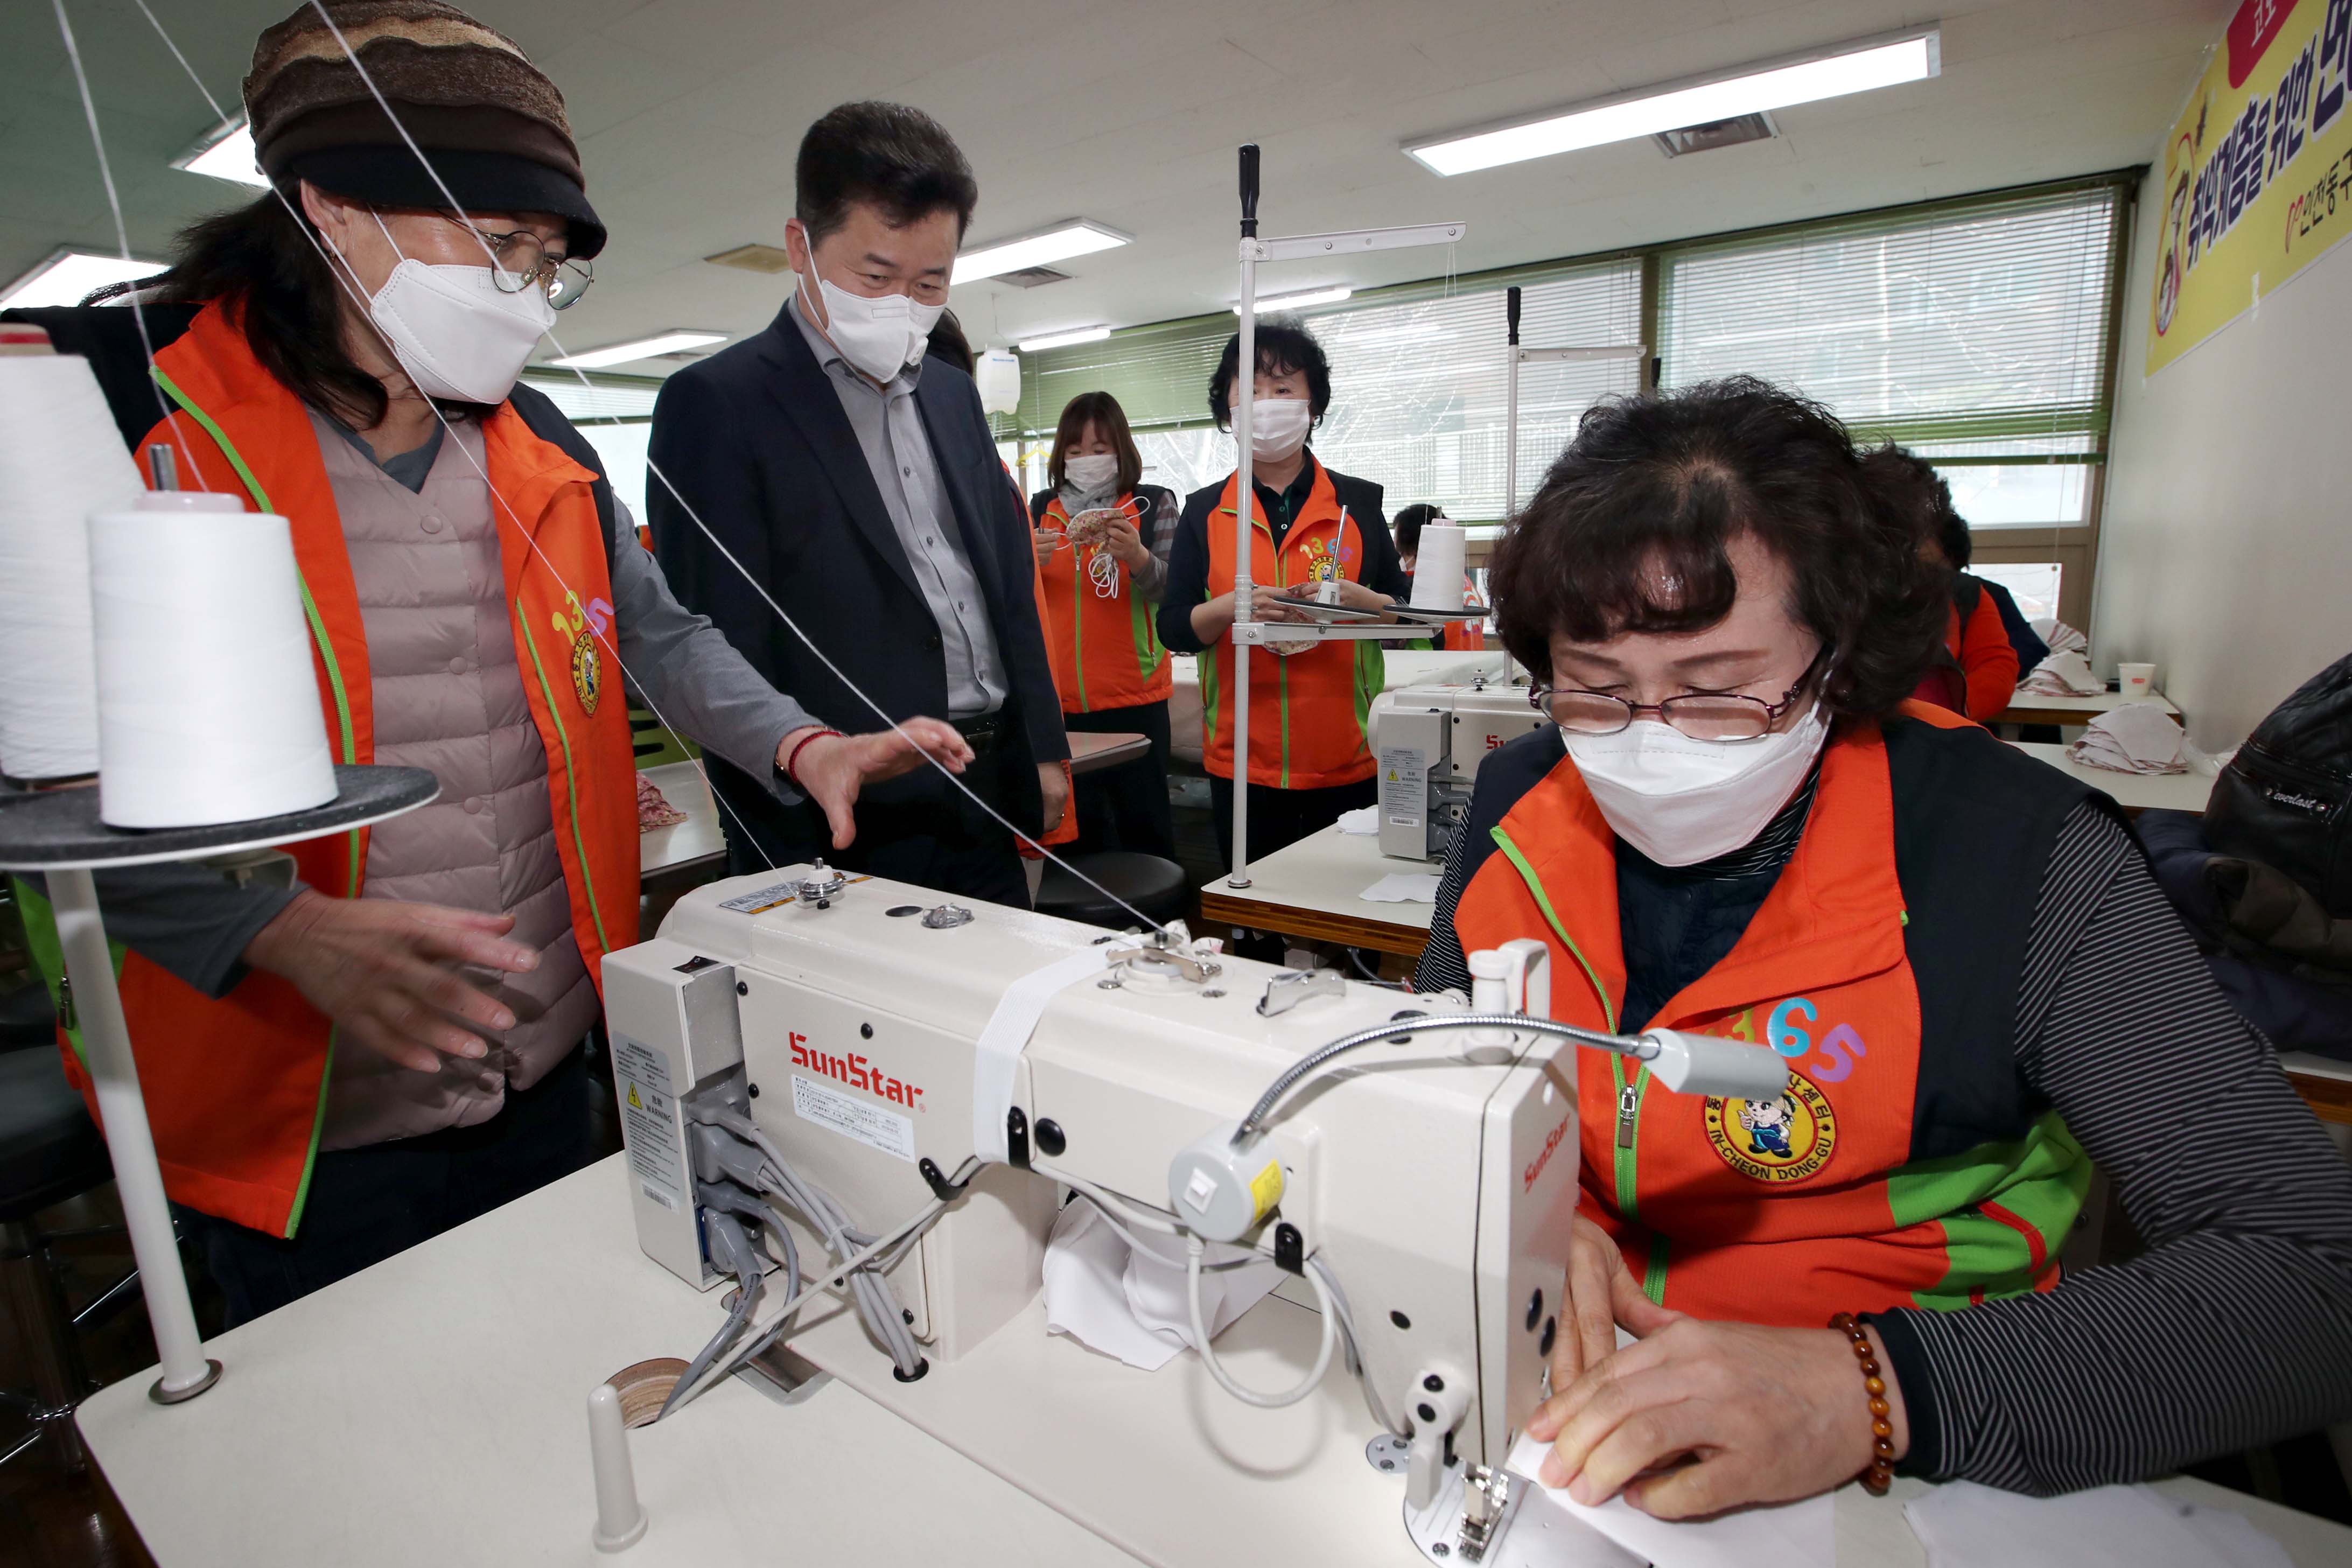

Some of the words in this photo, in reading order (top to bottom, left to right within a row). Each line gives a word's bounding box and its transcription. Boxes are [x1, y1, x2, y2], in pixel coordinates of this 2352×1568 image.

[2268, 33, 2317, 183] 위한
[789, 1031, 923, 1108] SunStar
[646, 1103, 672, 1124] WARNING
[1525, 1111, 1571, 1195] SunStar
[1709, 1130, 1771, 1179] IN-CHEON
[1777, 1137, 1832, 1180] DONG-GU
